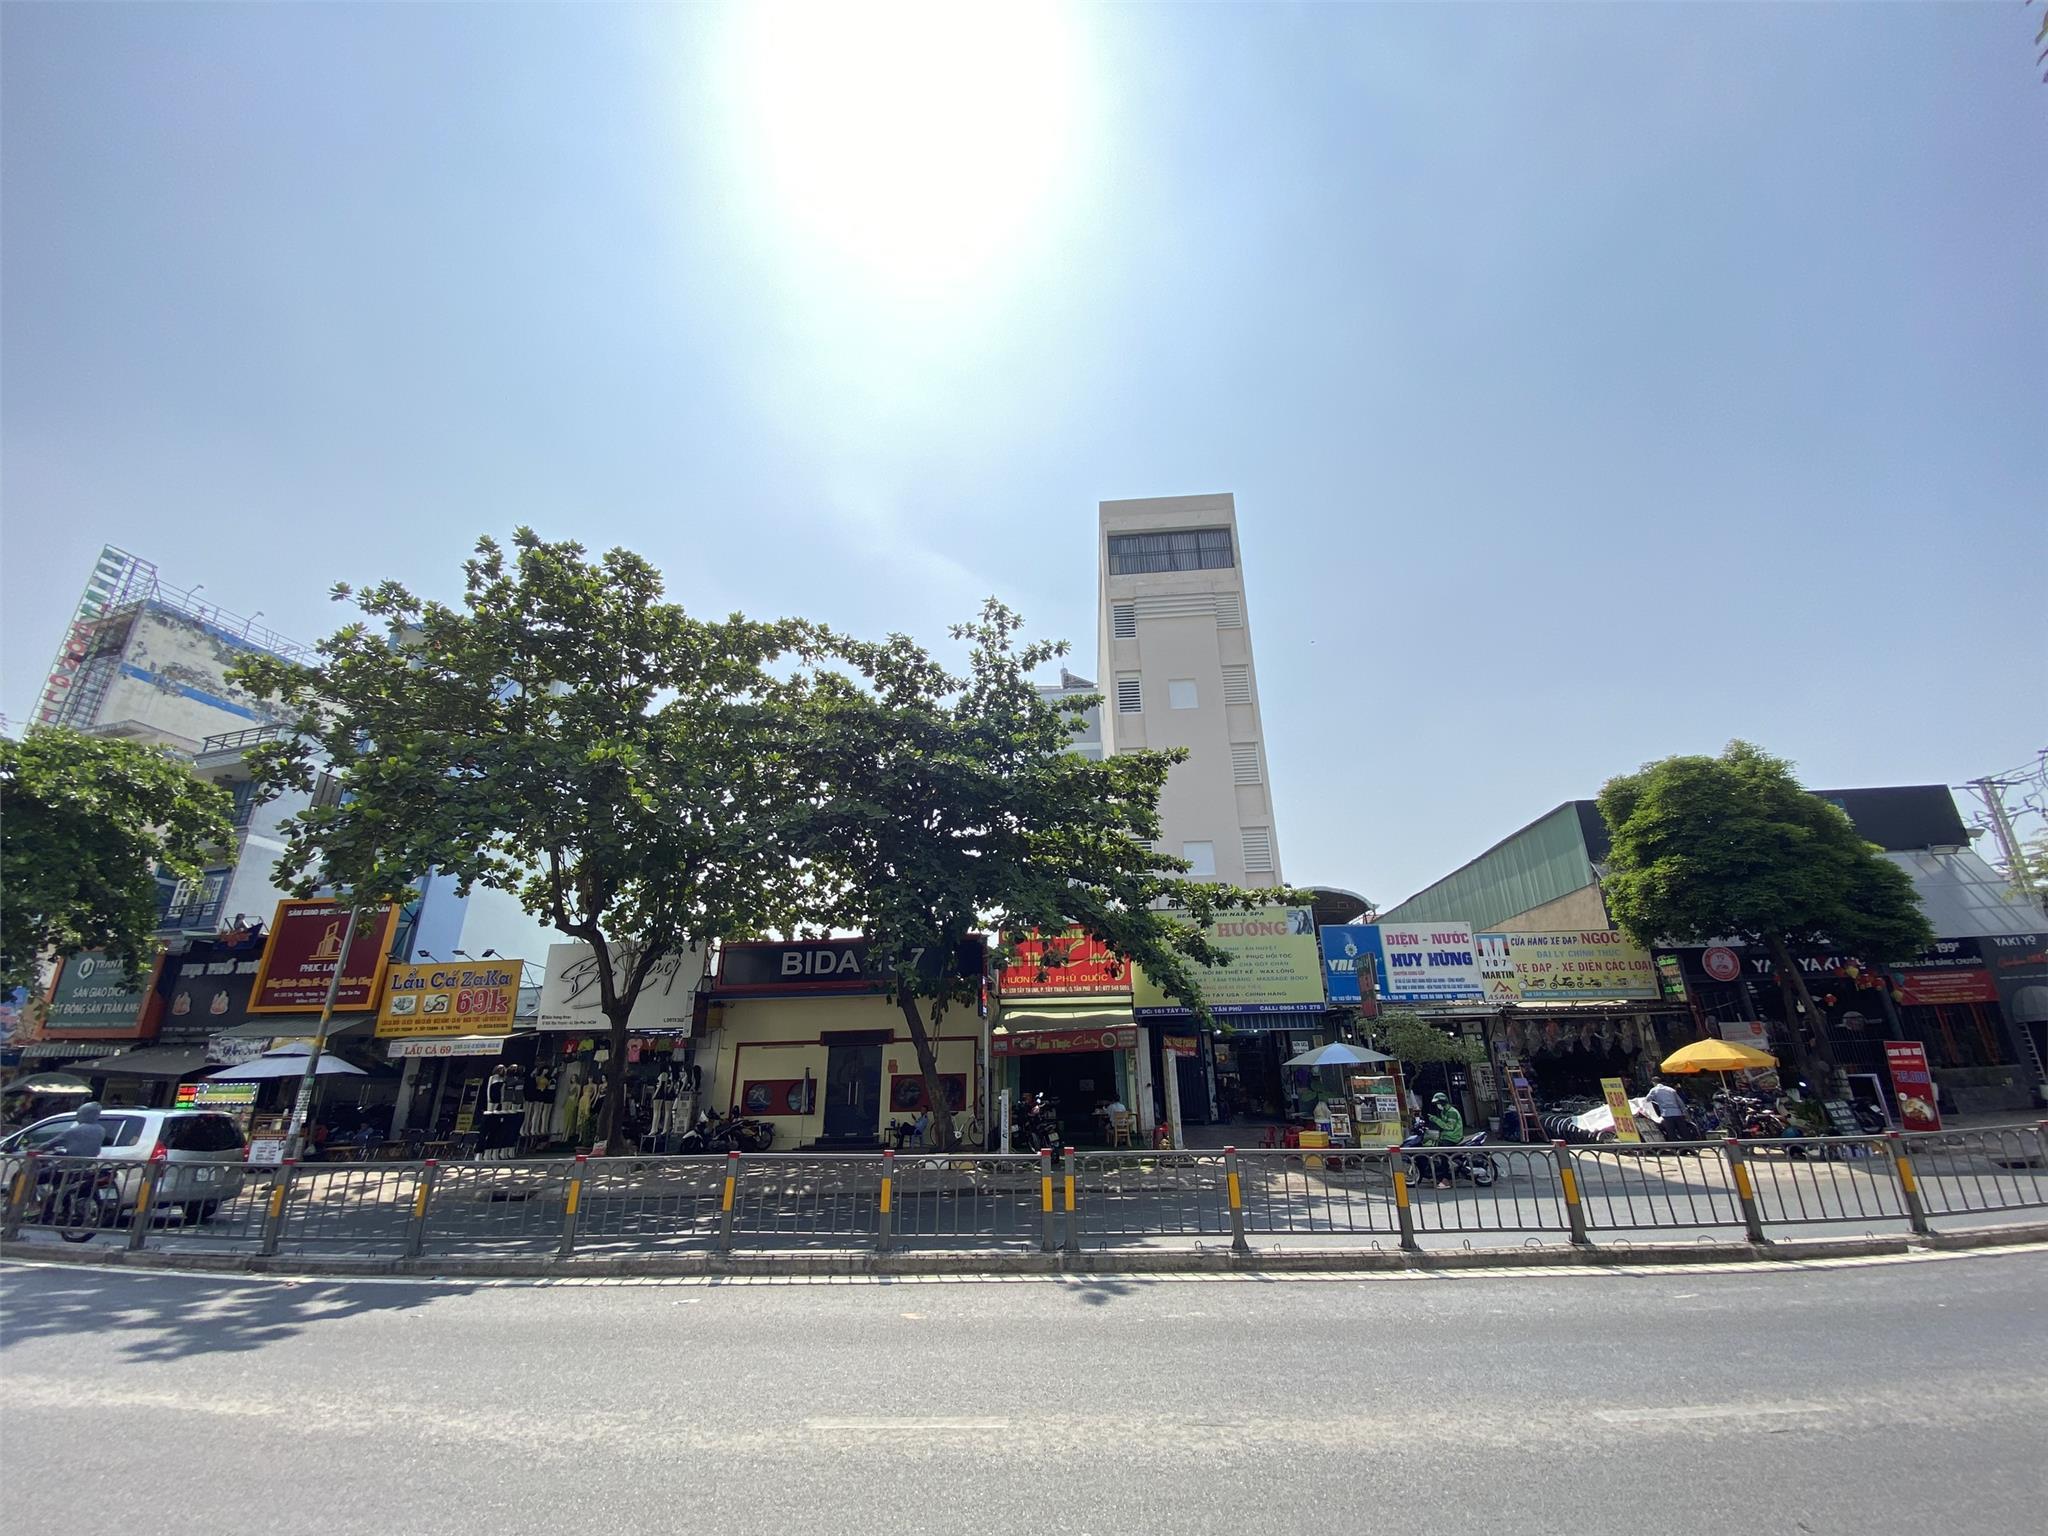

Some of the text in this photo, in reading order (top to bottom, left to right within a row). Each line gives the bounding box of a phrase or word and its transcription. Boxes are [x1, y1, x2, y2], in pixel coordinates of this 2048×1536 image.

[1216, 918, 1288, 938] HƯƠNG
[1385, 931, 1469, 948] ĐIỆN NƯỚC
[1510, 936, 1526, 946] CỬA
[1549, 936, 1560, 945] XE
[1580, 932, 1621, 948] NGỌC
[1993, 936, 2020, 947] YAKI
[781, 950, 861, 976] BIDA
[1391, 949, 1474, 968] HUY HÙNG
[1797, 957, 1841, 972] YAKI
[1515, 963, 1529, 973] XE
[1531, 962, 1552, 974] ĐẠP
[1561, 961, 1575, 972] XE
[1604, 959, 1626, 971] CÁC
[1628, 959, 1652, 973] LOẠI
[391, 967, 514, 991] Lẩu Cá ZaKa
[1080, 972, 1109, 983] QUỐC
[1482, 971, 1515, 980] MARTIN
[440, 1044, 452, 1055] 69
